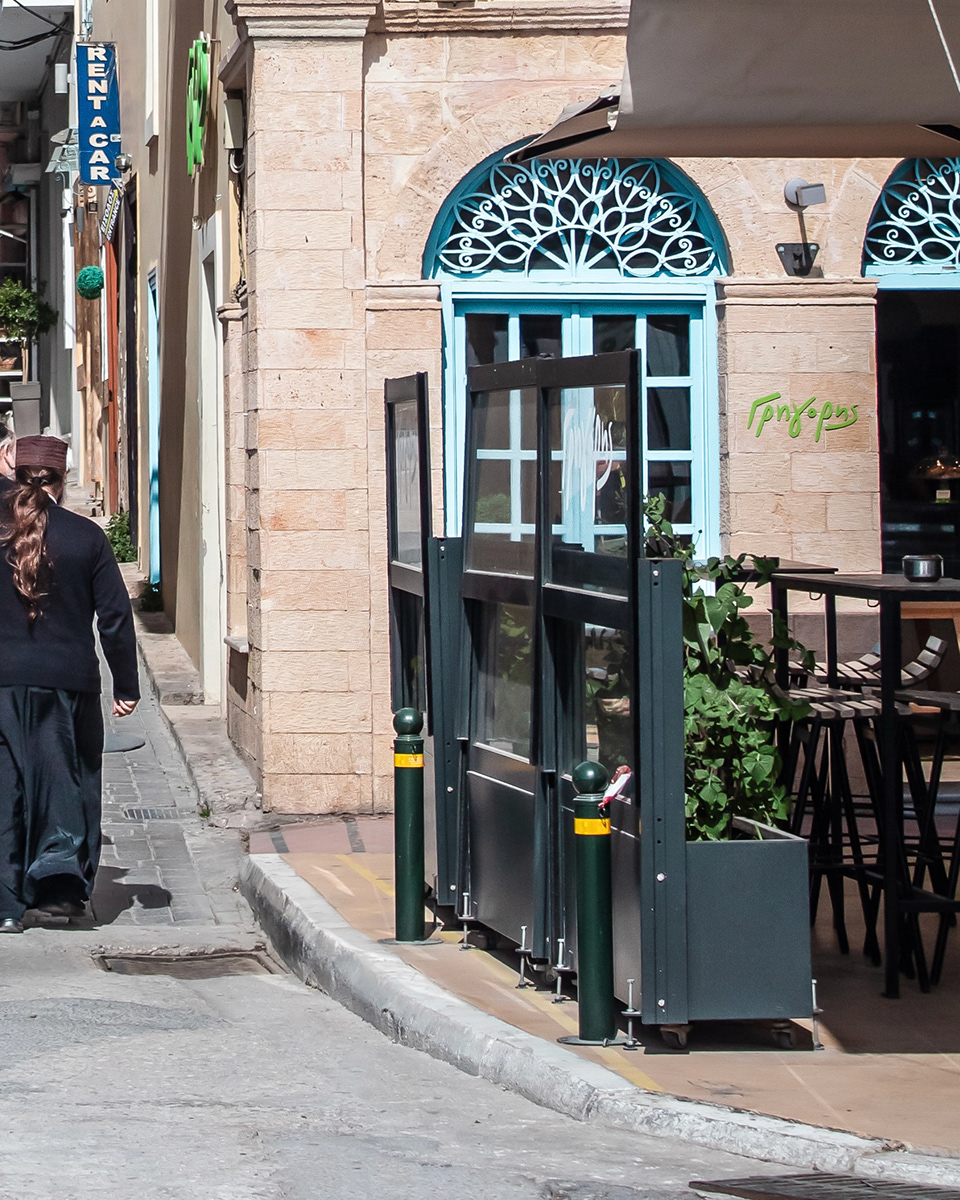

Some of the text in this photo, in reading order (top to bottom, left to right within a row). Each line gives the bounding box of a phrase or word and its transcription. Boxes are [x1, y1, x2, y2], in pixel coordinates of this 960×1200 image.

[87, 46, 111, 181] RENT A CAR
[106, 197, 121, 241] ENTRANCE
